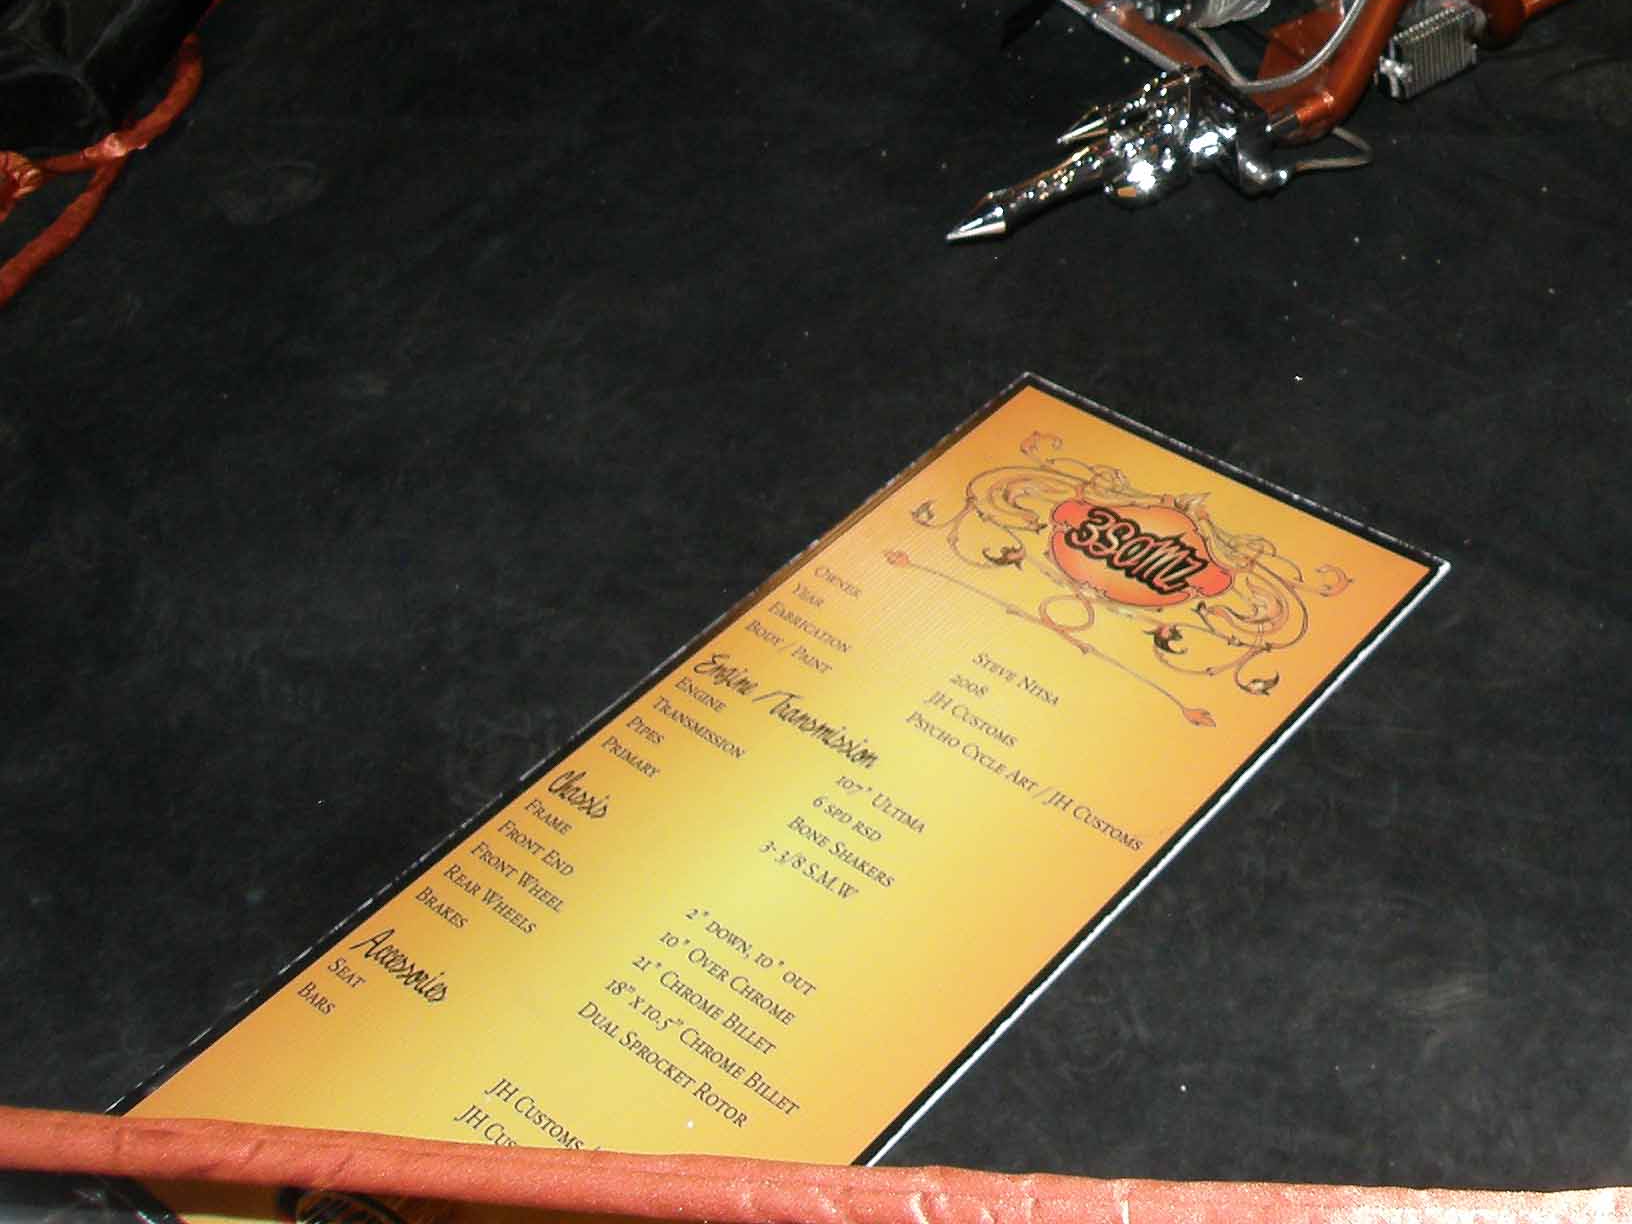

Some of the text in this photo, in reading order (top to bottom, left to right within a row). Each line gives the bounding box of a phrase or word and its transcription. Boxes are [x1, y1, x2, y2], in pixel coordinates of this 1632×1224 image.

[675, 676, 727, 713] ENGINE
[924, 690, 1019, 748] JH CUSTOMS
[626, 714, 665, 745] PIPES
[653, 695, 746, 759] TRANSMISSION
[600, 735, 661, 778] PRIMARY
[905, 711, 961, 748] PSYCHO
[961, 742, 1007, 775] CYCLE
[1006, 769, 1039, 792] ART
[1042, 791, 1074, 812] JH
[1073, 804, 1144, 852] CUSTOMS
[524, 798, 573, 836] FRAME
[812, 795, 883, 842] 6 SPD RSD
[871, 792, 926, 833] ULTIMA
[470, 840, 565, 913] FRONT WHEEL
[497, 819, 575, 877] FRONT END
[787, 815, 896, 888] BONE SHAKERS
[415, 885, 468, 929] BRAKES
[443, 863, 537, 935] REAR WHEELS
[327, 957, 366, 989] SEAT
[687, 947, 730, 982] OVER
[729, 975, 796, 1026] CHROME
[705, 920, 753, 959] DOWN,
[782, 970, 817, 997] OUT
[297, 981, 336, 1016] BARS
[659, 970, 725, 1021] CHROME
[722, 1012, 777, 1056] BILLET
[577, 1001, 749, 1128] DUAL SPROCKET ROTOR
[628, 995, 646, 1010] X
[679, 1027, 746, 1080] CHROME
[744, 1071, 800, 1116] BILLET
[453, 1104, 490, 1129] JH
[484, 1077, 585, 1151] JH CUSTOMS
